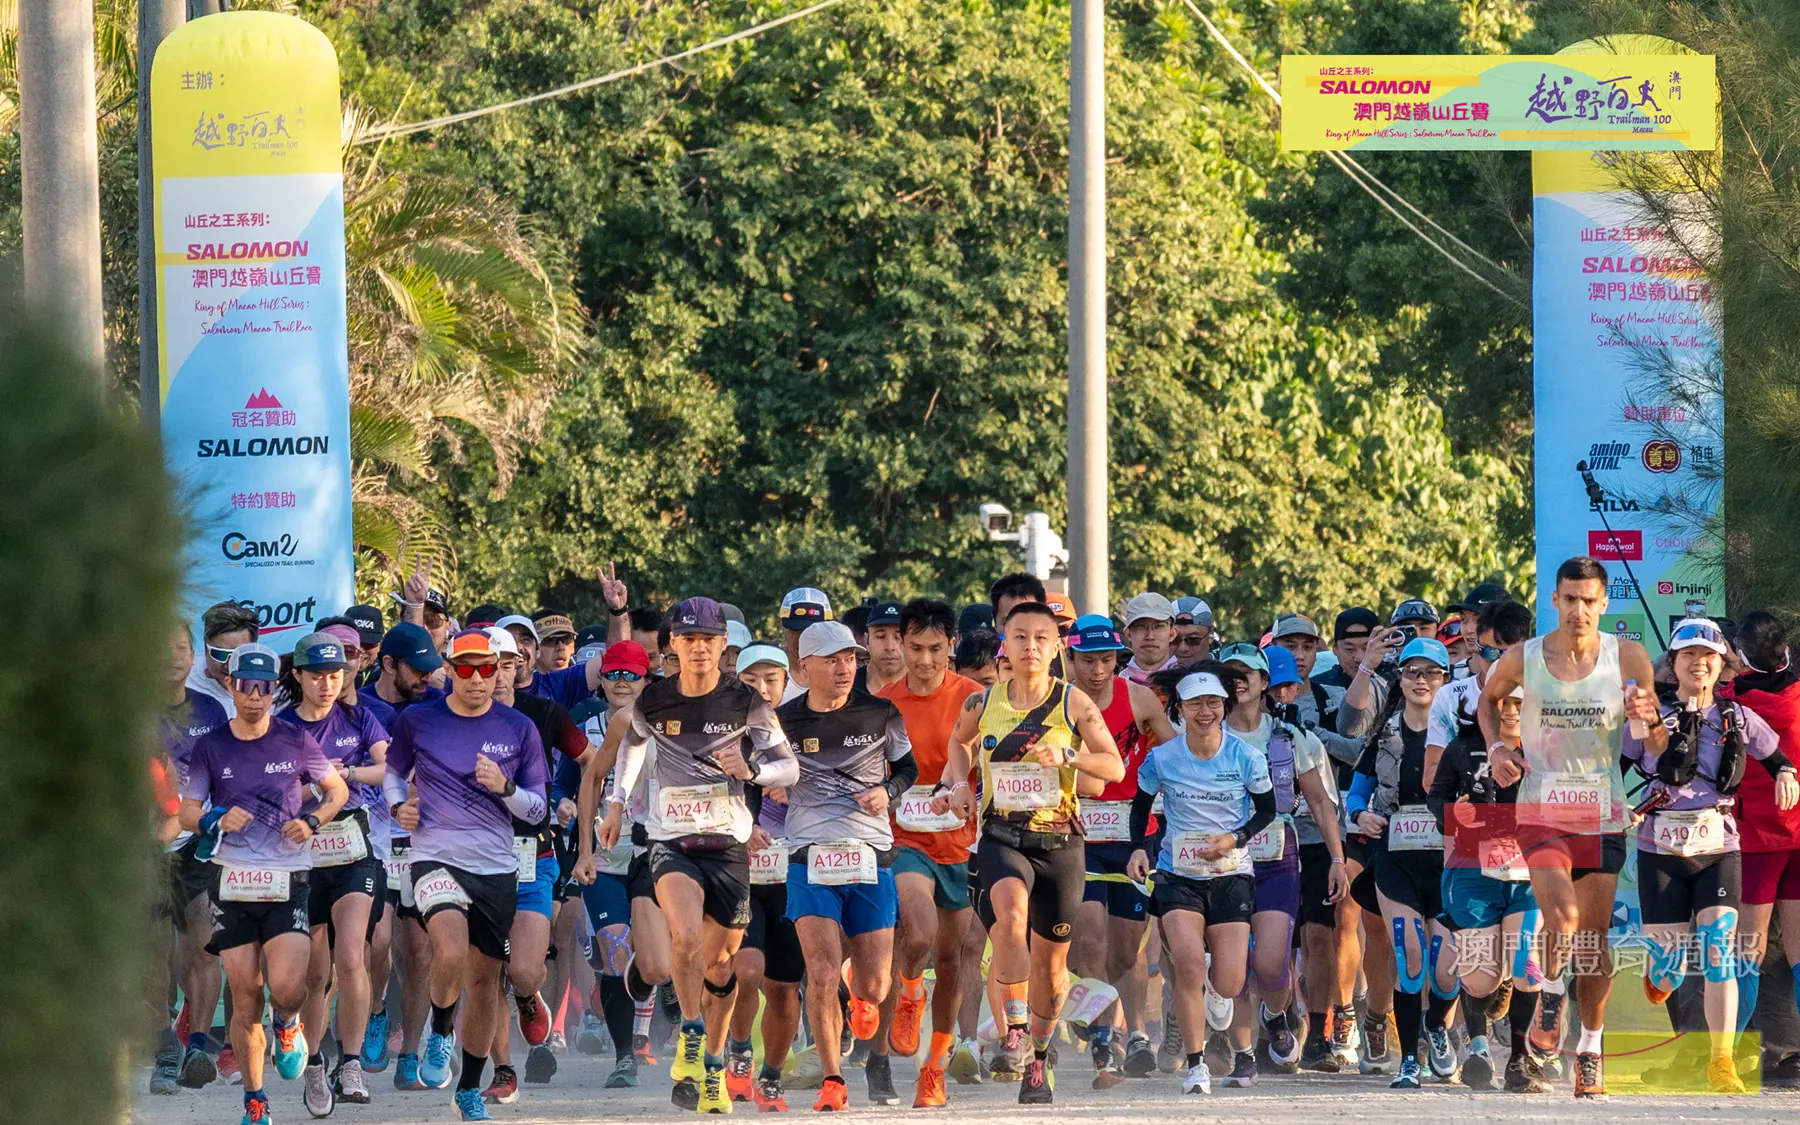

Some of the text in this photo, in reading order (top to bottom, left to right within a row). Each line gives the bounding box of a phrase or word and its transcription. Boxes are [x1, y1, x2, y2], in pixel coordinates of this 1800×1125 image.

[187, 240, 309, 260] SALOMON
[197, 436, 329, 457] SALOMON
[1589, 440, 1630, 456] amino
[1588, 456, 1621, 470] VITAL
[1541, 707, 1605, 717] SALOMON
[997, 778, 1042, 793] A1088
[1547, 789, 1598, 804] A1068
[666, 801, 712, 817] A1247
[1079, 812, 1119, 825] A1292
[1393, 820, 1437, 834] A1077
[1661, 825, 1708, 840] A1070
[814, 851, 861, 868] A1219
[227, 871, 273, 884] A1149
